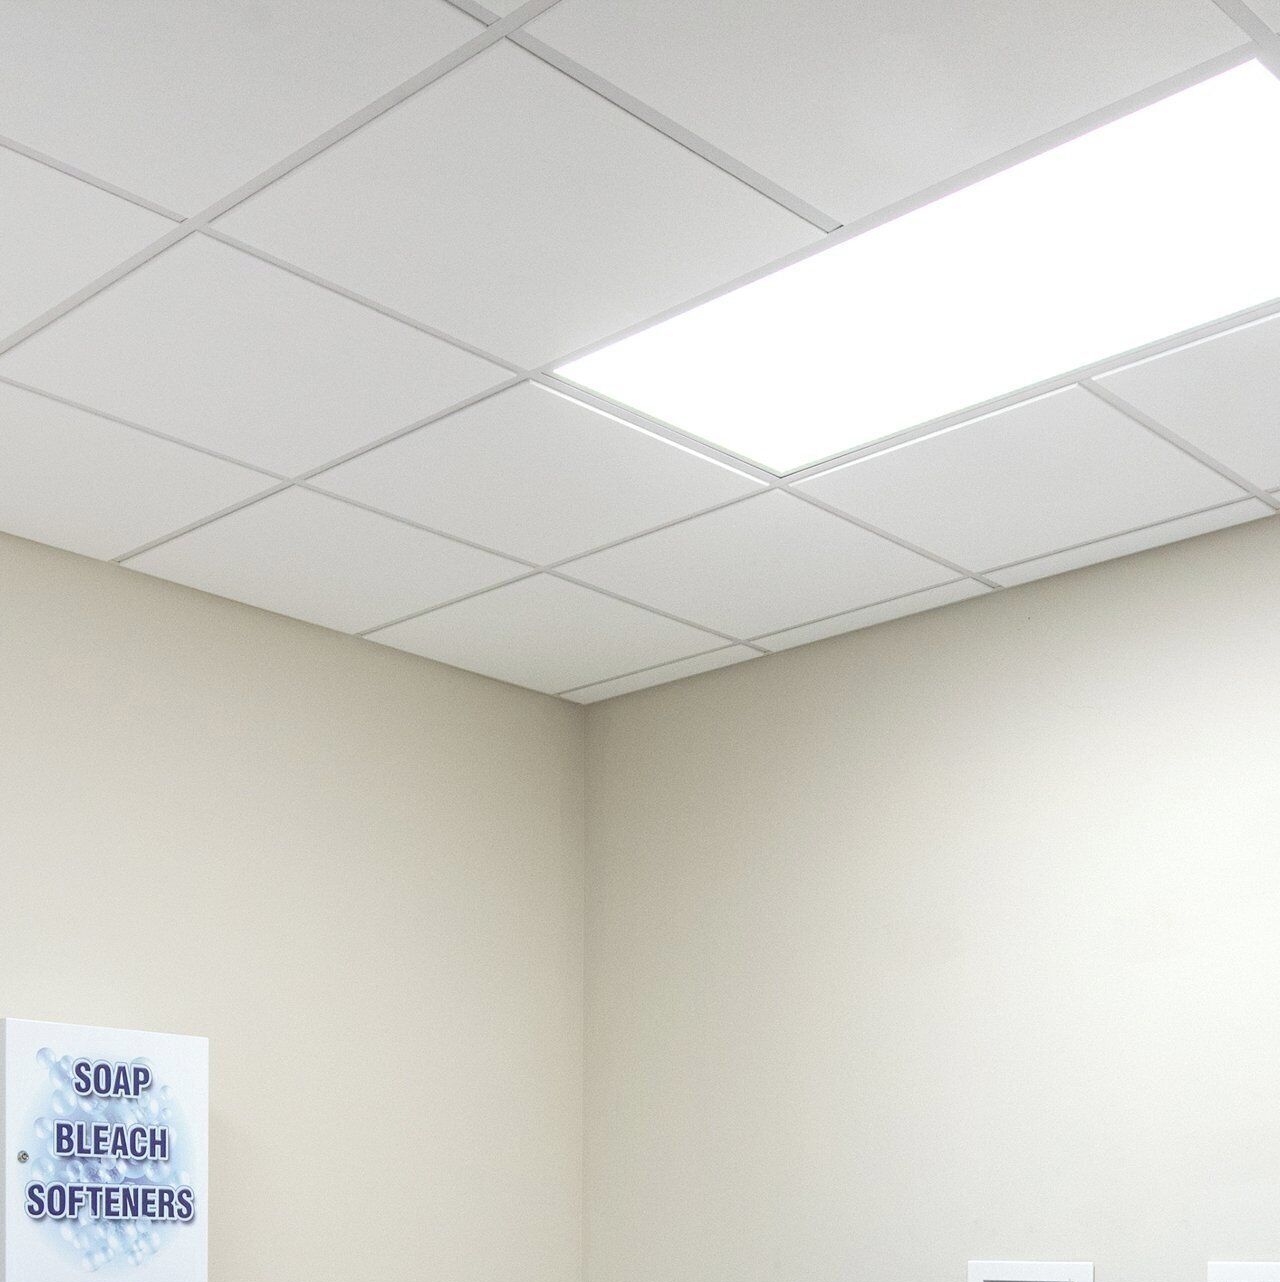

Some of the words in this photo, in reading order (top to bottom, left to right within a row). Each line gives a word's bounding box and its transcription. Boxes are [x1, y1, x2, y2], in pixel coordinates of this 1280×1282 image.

[74, 1061, 151, 1097] SOAP
[55, 1122, 168, 1159] BLEACH
[27, 1183, 194, 1220] SOFTENERS
